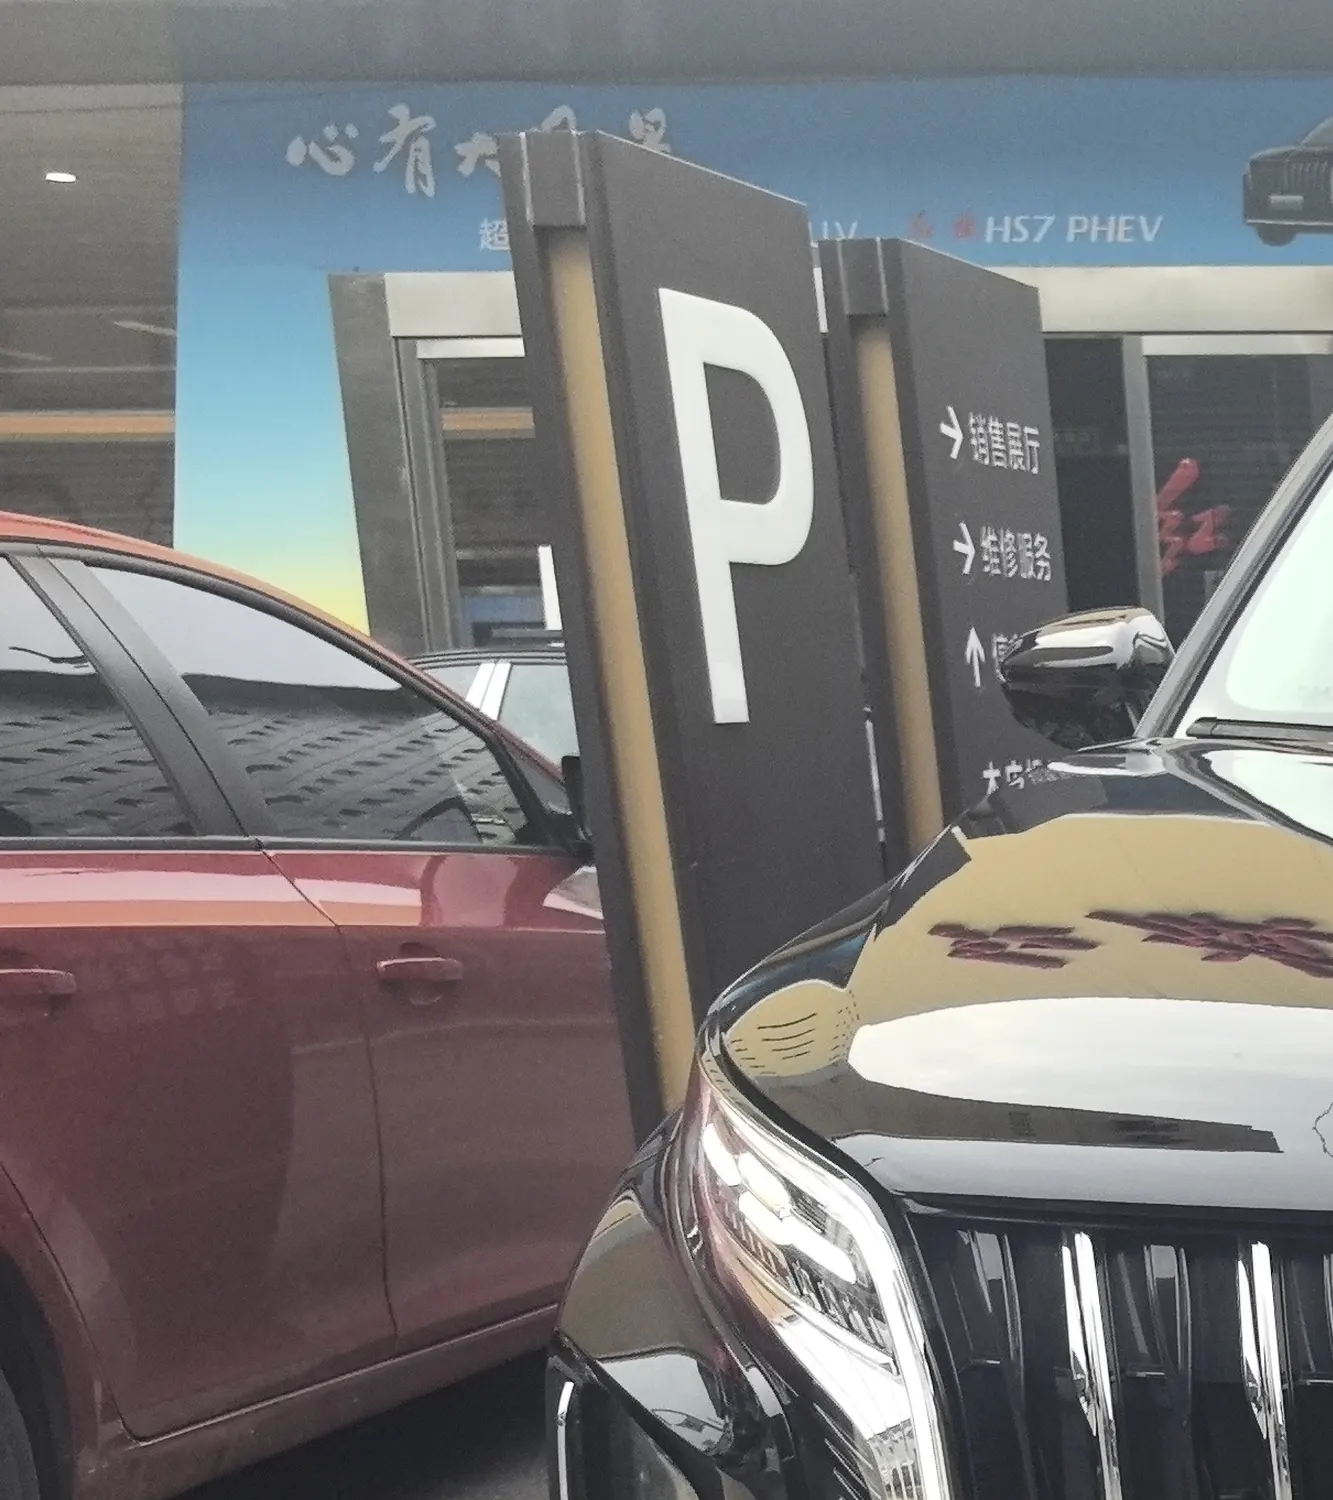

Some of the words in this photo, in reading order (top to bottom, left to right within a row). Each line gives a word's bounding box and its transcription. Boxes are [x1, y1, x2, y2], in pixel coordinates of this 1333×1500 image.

[985, 214, 1056, 244] HS7
[1065, 213, 1164, 244] PHEV
[968, 411, 1041, 475] 销售展厅
[659, 287, 815, 724] P
[980, 525, 1053, 582] 维修服务
